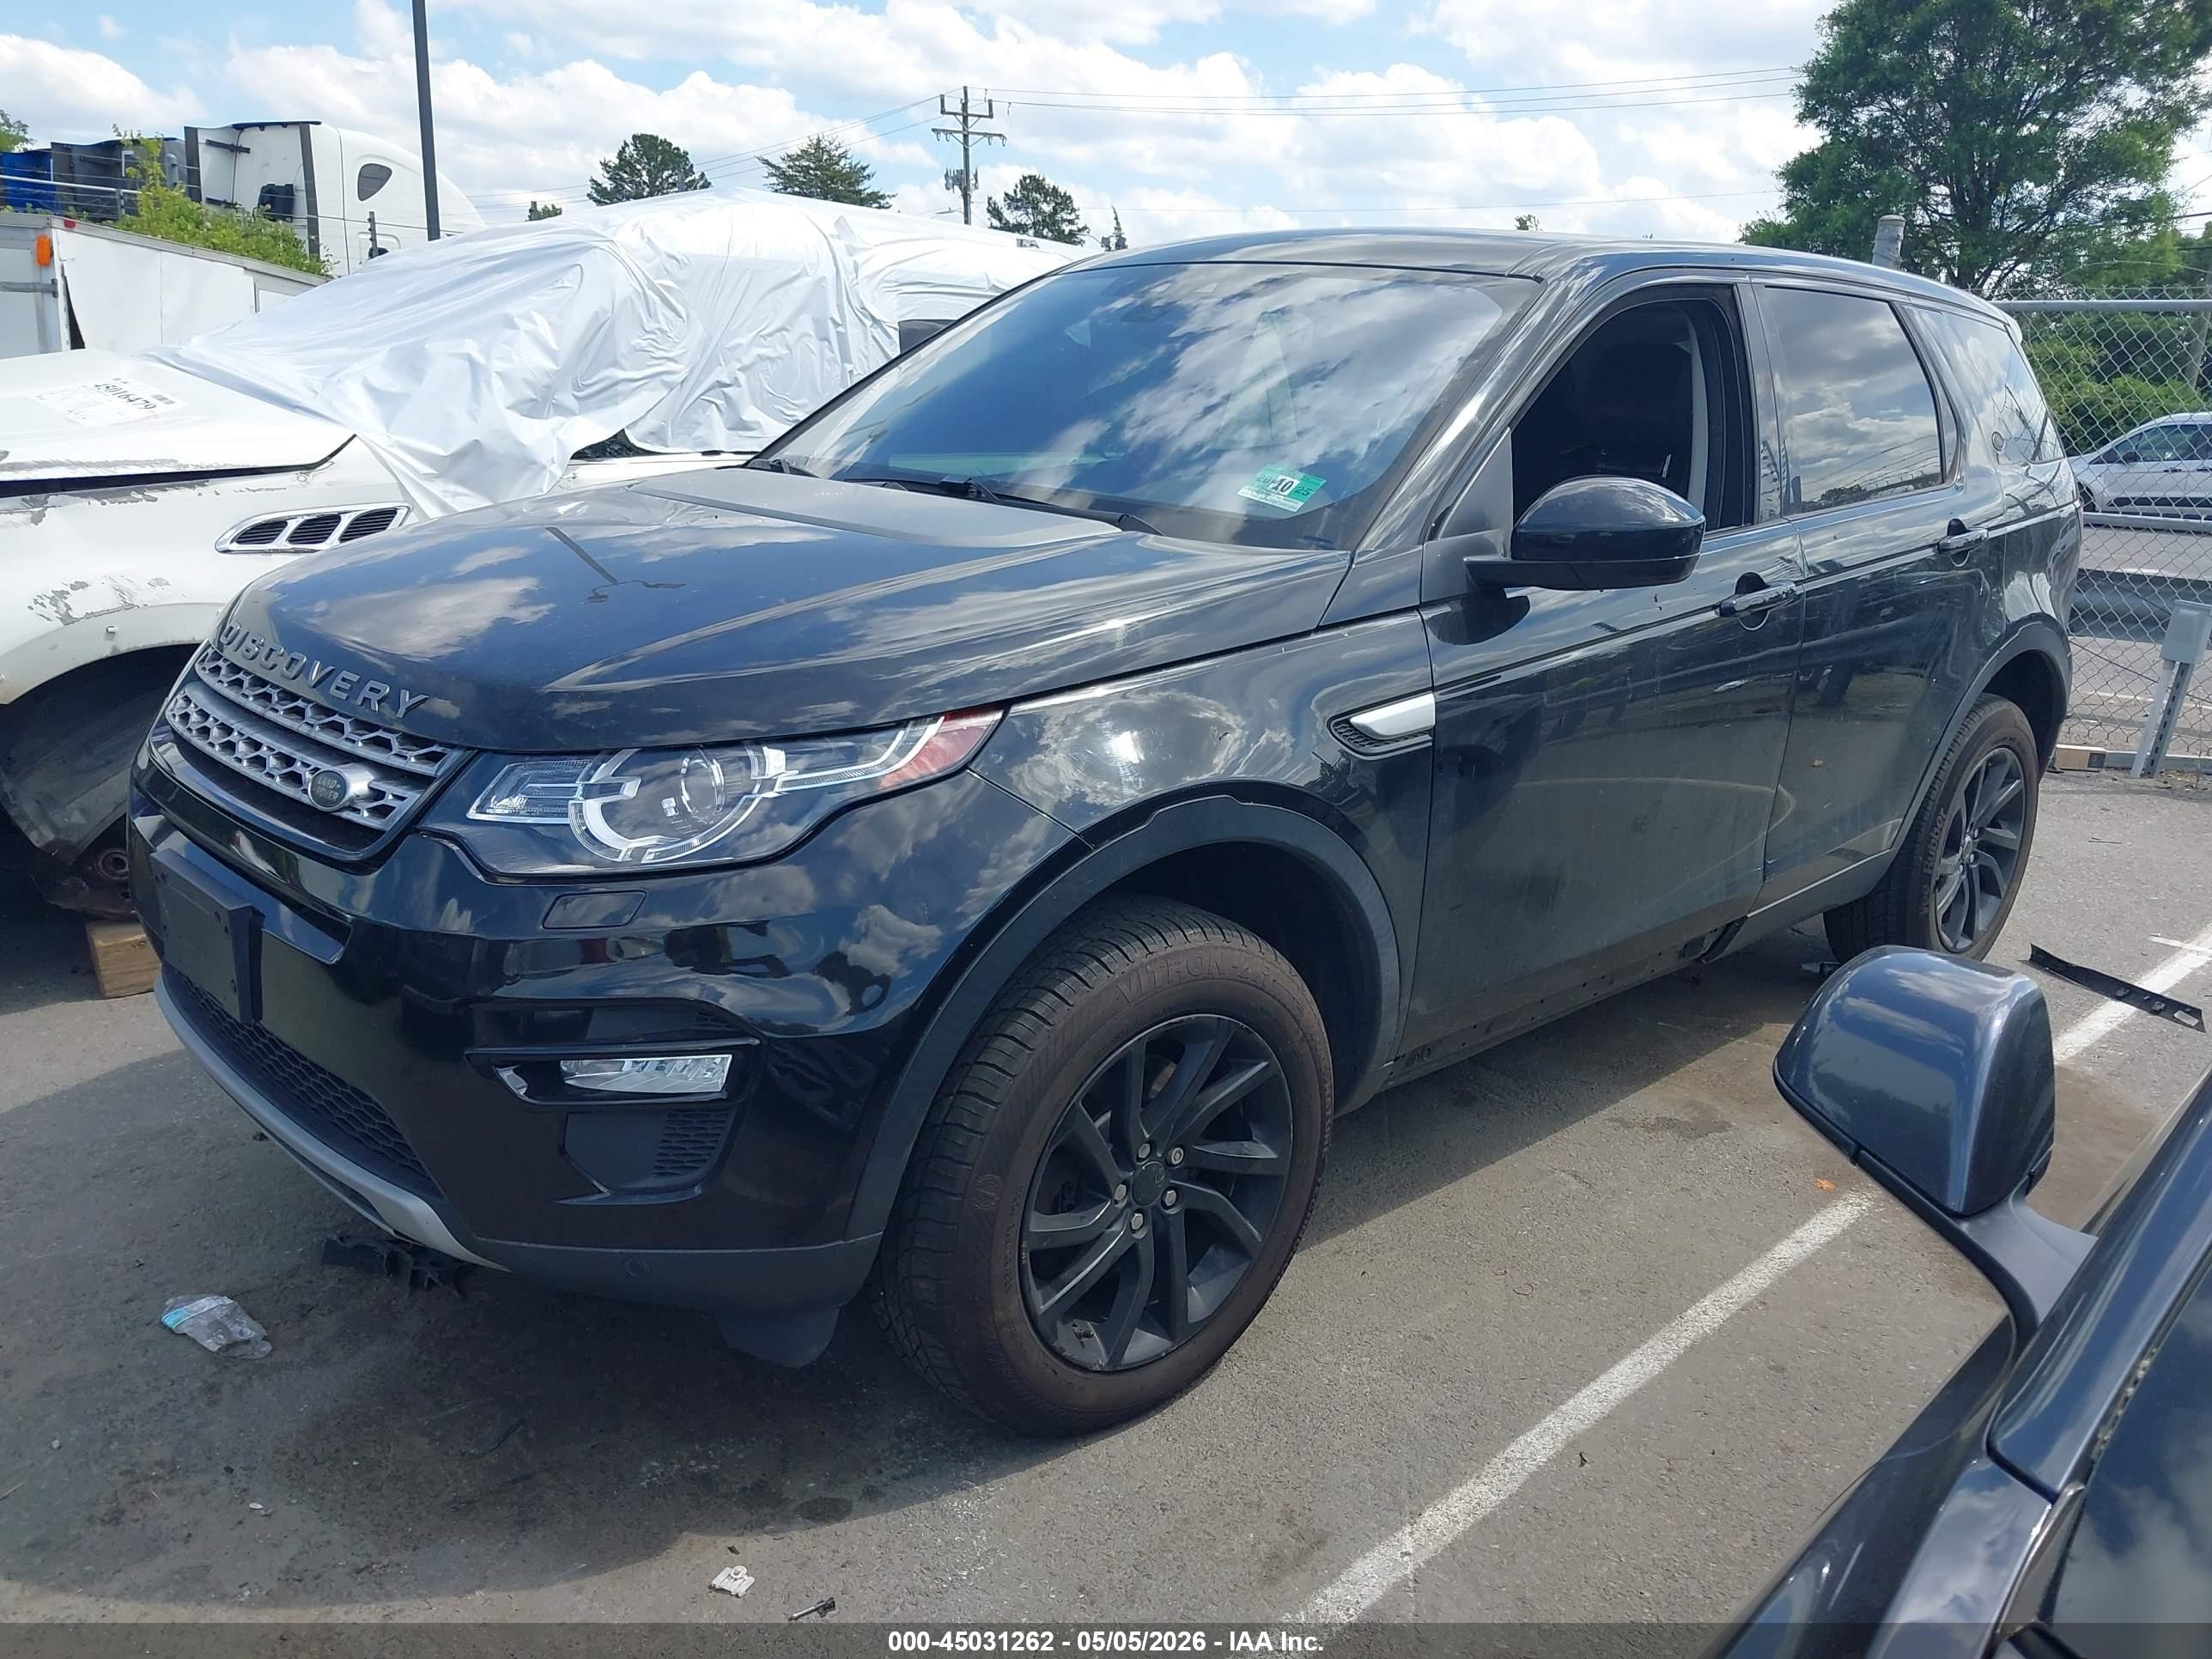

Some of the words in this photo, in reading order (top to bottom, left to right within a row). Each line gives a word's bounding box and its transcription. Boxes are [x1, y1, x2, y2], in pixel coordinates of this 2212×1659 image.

[1273, 477, 1294, 494] 10
[1294, 485, 1313, 496] 25
[220, 621, 429, 719] DISCOVERY
